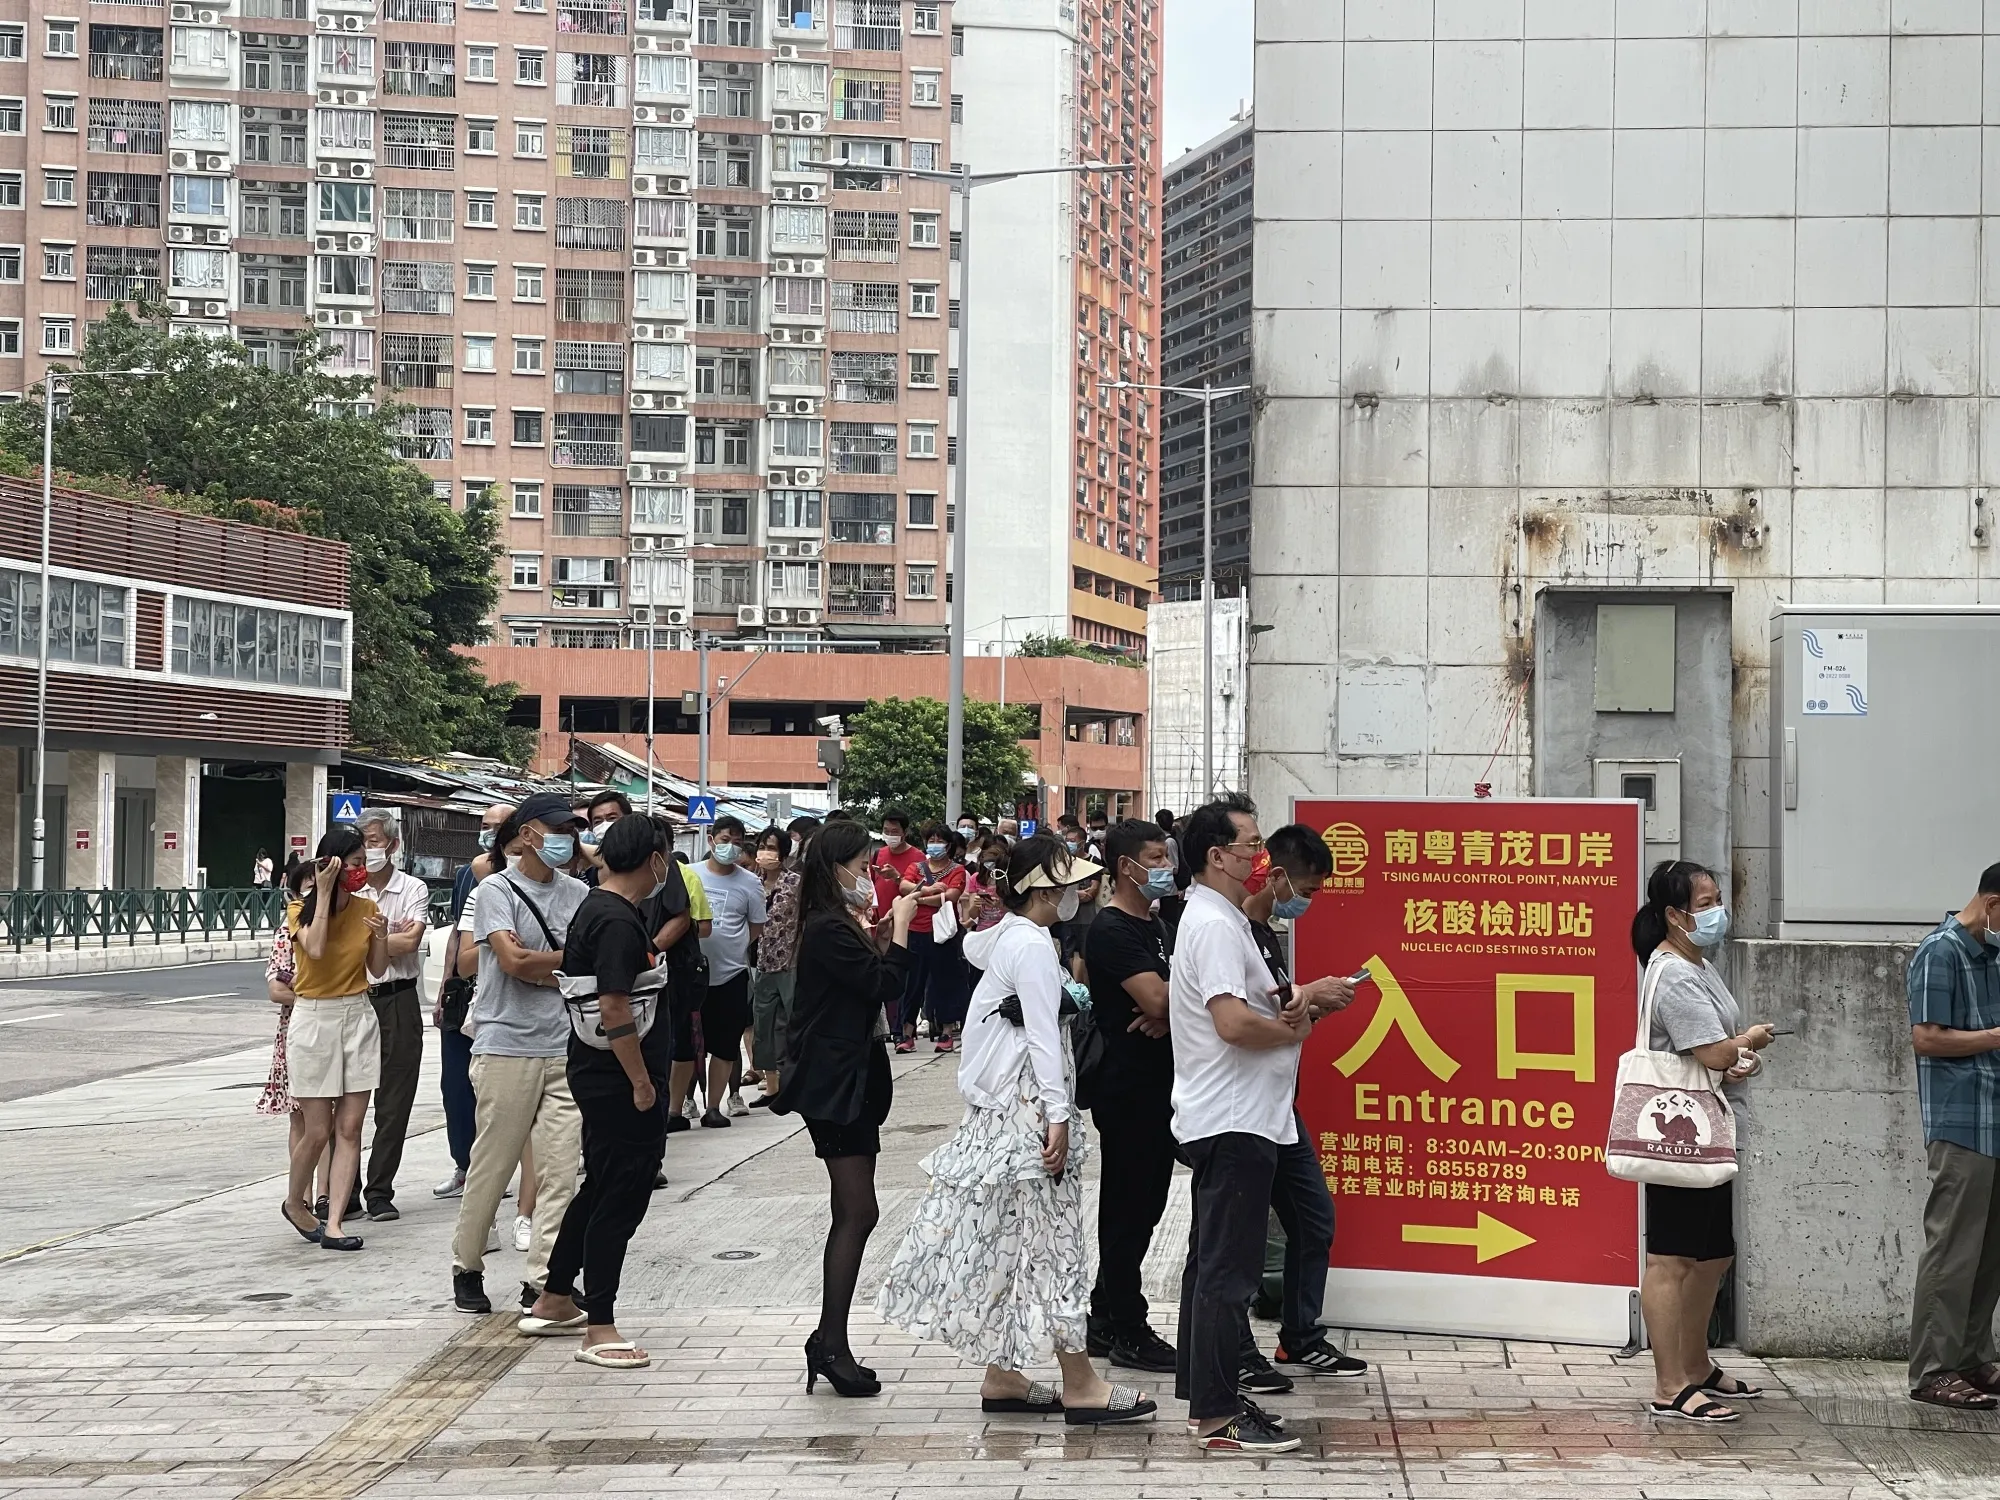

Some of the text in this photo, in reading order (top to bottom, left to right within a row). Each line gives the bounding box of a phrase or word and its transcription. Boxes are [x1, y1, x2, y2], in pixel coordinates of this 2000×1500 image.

[1020, 820, 1029, 833] P
[1384, 828, 1614, 868] 南粤青茂口岸
[1381, 871, 1618, 887] TSING MAU CONTROL POINT, NANYUE
[1403, 898, 1594, 938] 核酸檢測站
[1401, 942, 1596, 957] NUCLEIC ACID SESTING STATION
[1332, 955, 1596, 1083] 入口
[1355, 1083, 1576, 1130] Entrance
[1656, 1094, 1695, 1112] らくだ
[1647, 1143, 1702, 1156] RAKUDA
[1426, 1160, 1527, 1180] 68558789
